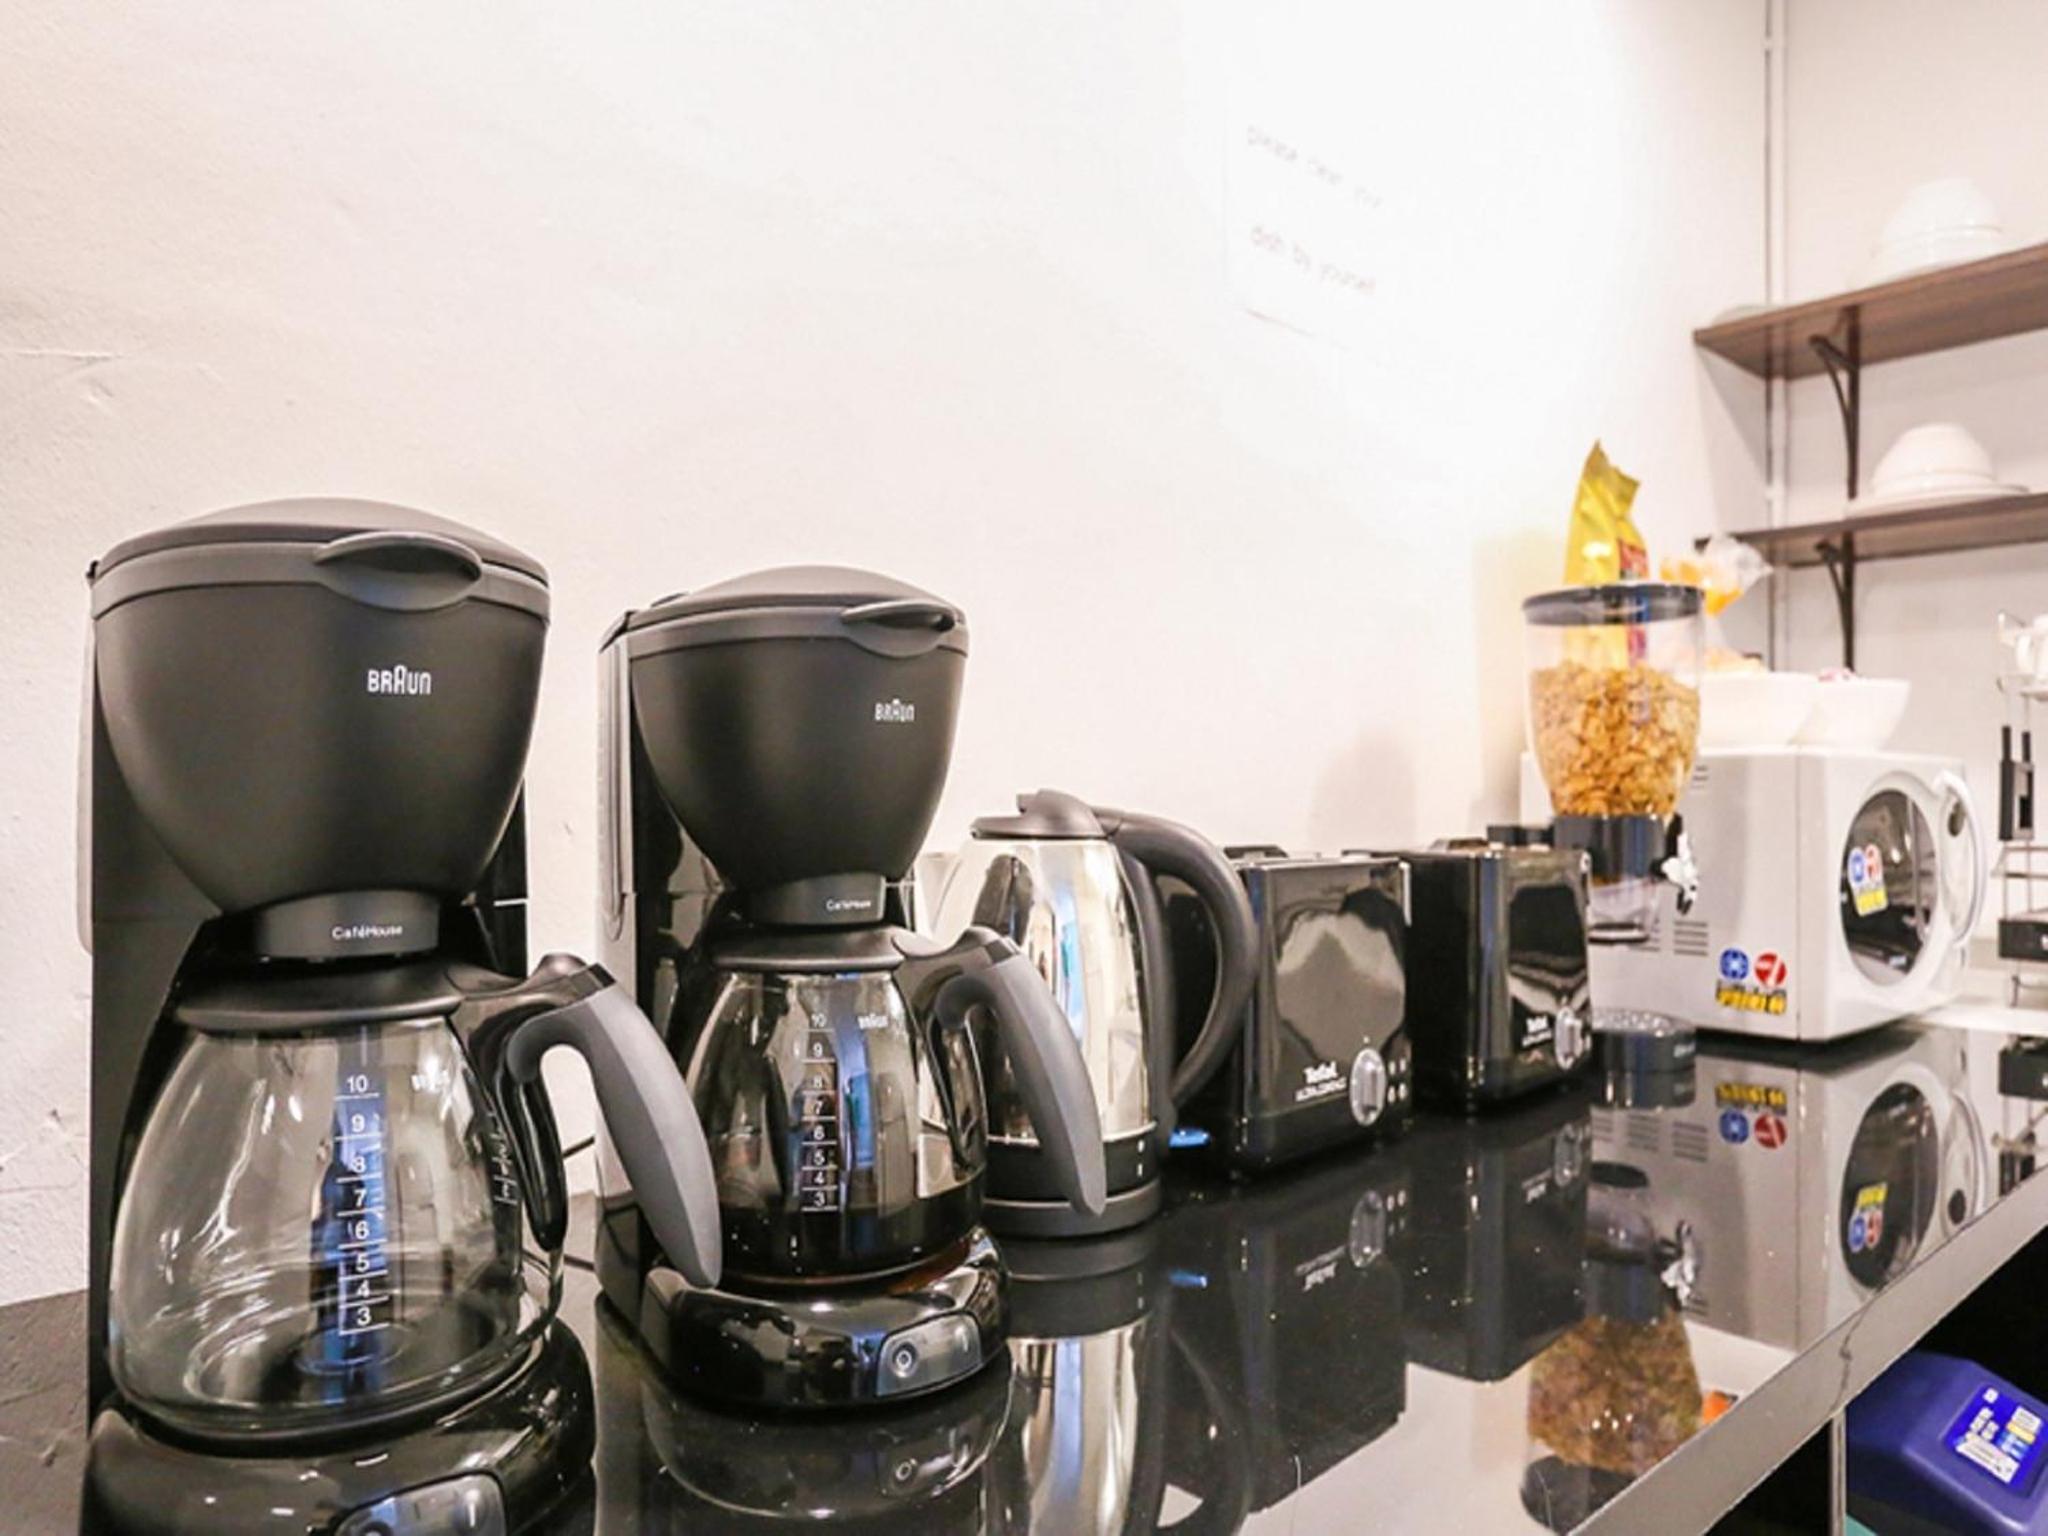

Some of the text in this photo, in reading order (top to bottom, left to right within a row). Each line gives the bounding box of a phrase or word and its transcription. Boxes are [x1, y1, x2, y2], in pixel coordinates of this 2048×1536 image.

[366, 664, 432, 695] BRAUN
[813, 1043, 823, 1057] 9
[346, 1074, 369, 1093] 10
[351, 1114, 366, 1133] 9
[813, 1127, 825, 1140] 6
[352, 1155, 366, 1174] 8
[813, 1151, 825, 1165] 5
[813, 1170, 825, 1184] 4
[353, 1188, 367, 1207] 7
[814, 1192, 825, 1207] 3
[354, 1220, 369, 1240] 6
[355, 1254, 370, 1273] 5
[356, 1279, 370, 1298] 4
[356, 1306, 371, 1326] 3
